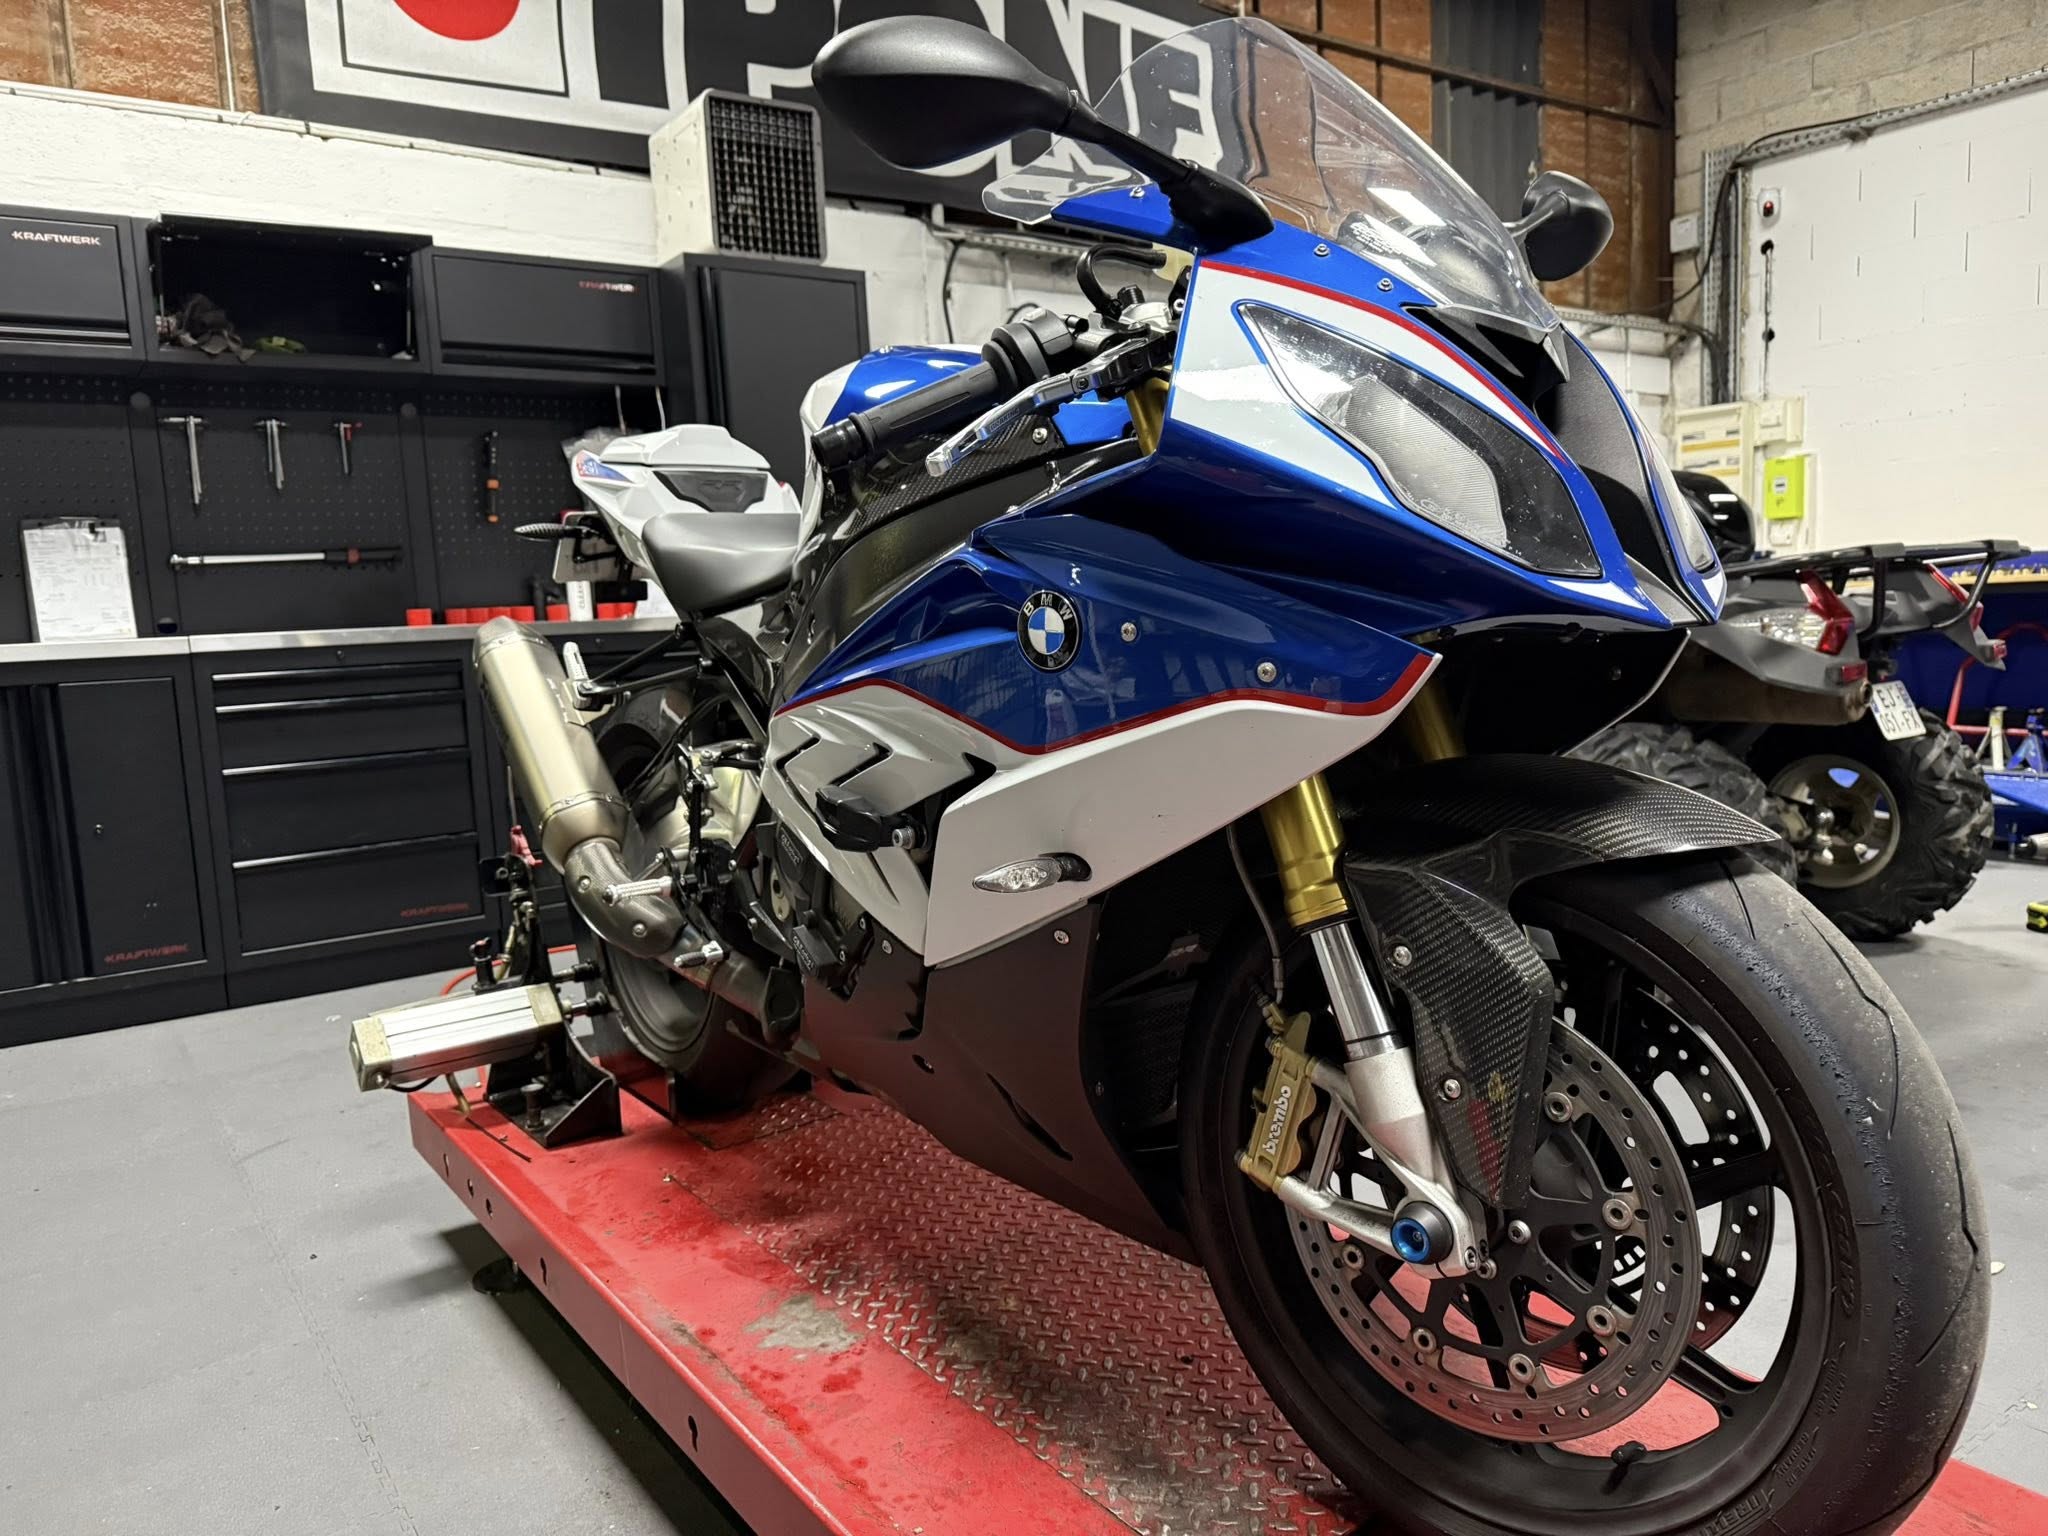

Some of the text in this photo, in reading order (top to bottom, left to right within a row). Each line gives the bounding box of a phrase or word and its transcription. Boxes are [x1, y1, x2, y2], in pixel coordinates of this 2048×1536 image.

[11, 230, 102, 247] KRAFTWERK
[1023, 593, 1073, 621] BMW
[104, 944, 189, 966] KRAFTWERK
[1262, 1085, 1292, 1156] brembo
